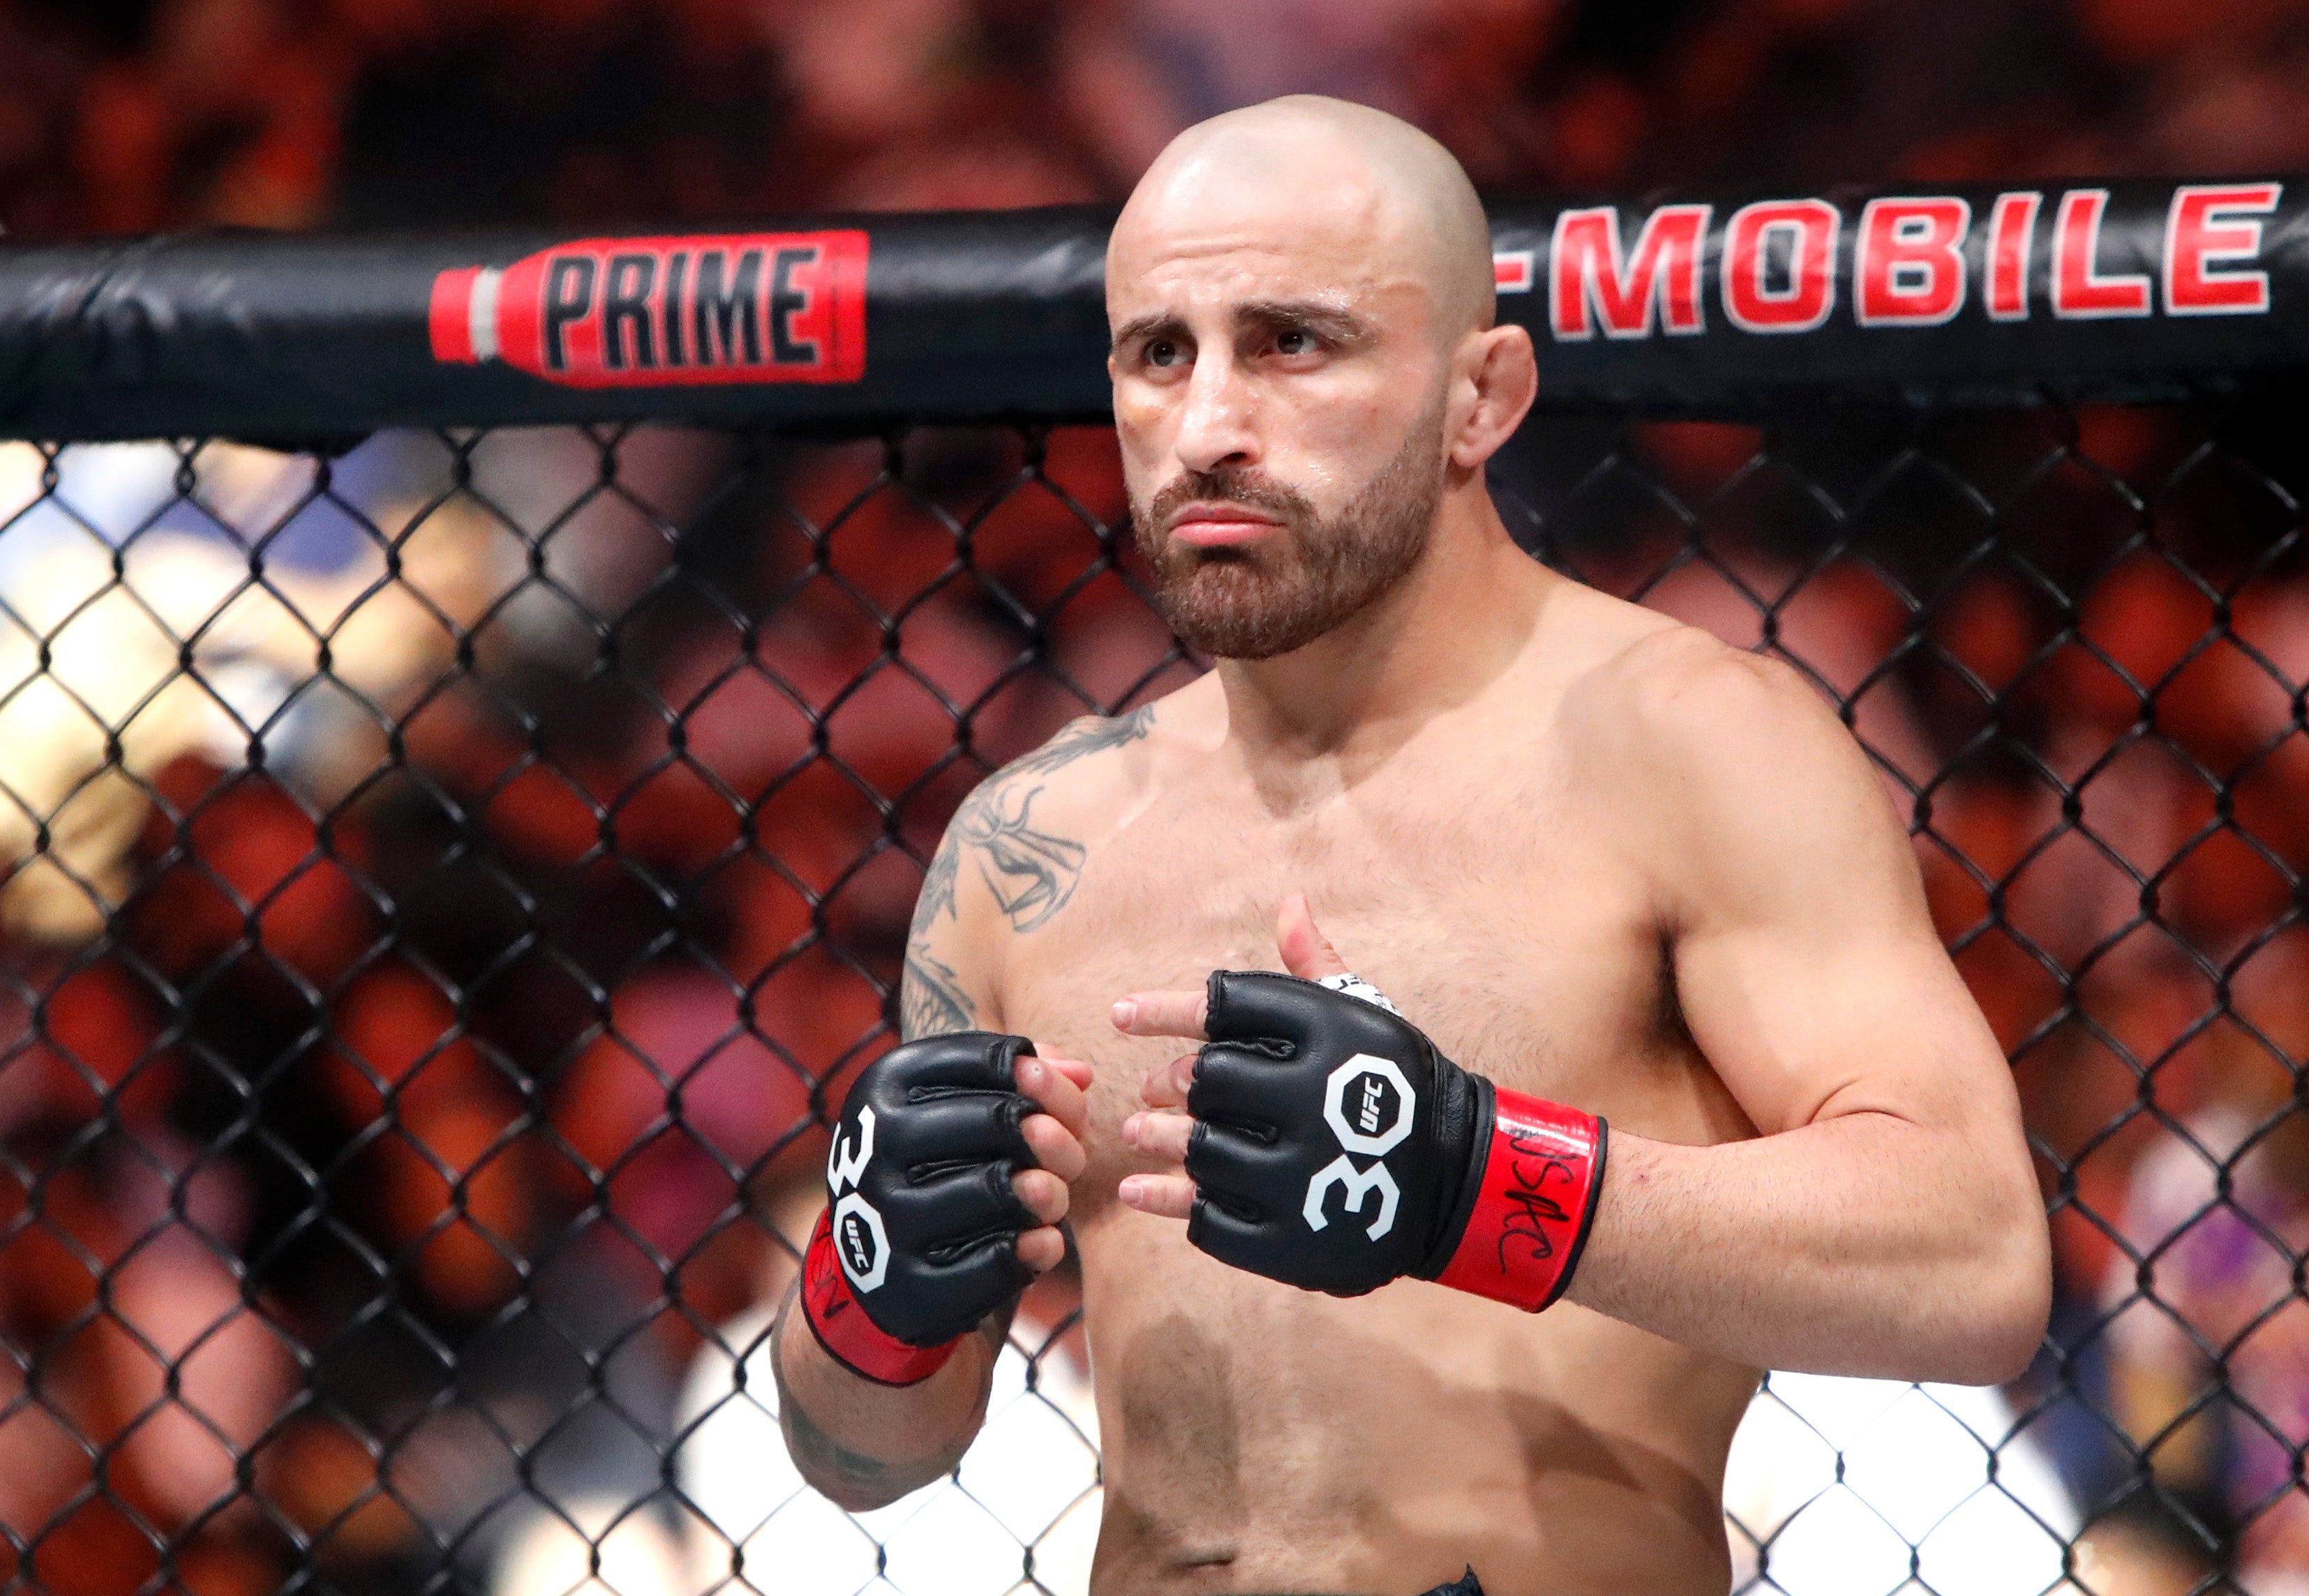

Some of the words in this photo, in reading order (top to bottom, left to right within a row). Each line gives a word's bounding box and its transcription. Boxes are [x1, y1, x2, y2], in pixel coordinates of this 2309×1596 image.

[541, 244, 822, 372] PRIME
[1495, 184, 2284, 342] -MOBILE
[1302, 1052, 1416, 1242] 30
[1359, 1076, 1384, 1134] UFC
[826, 1104, 891, 1294] 30
[845, 1218, 867, 1269] UFC
